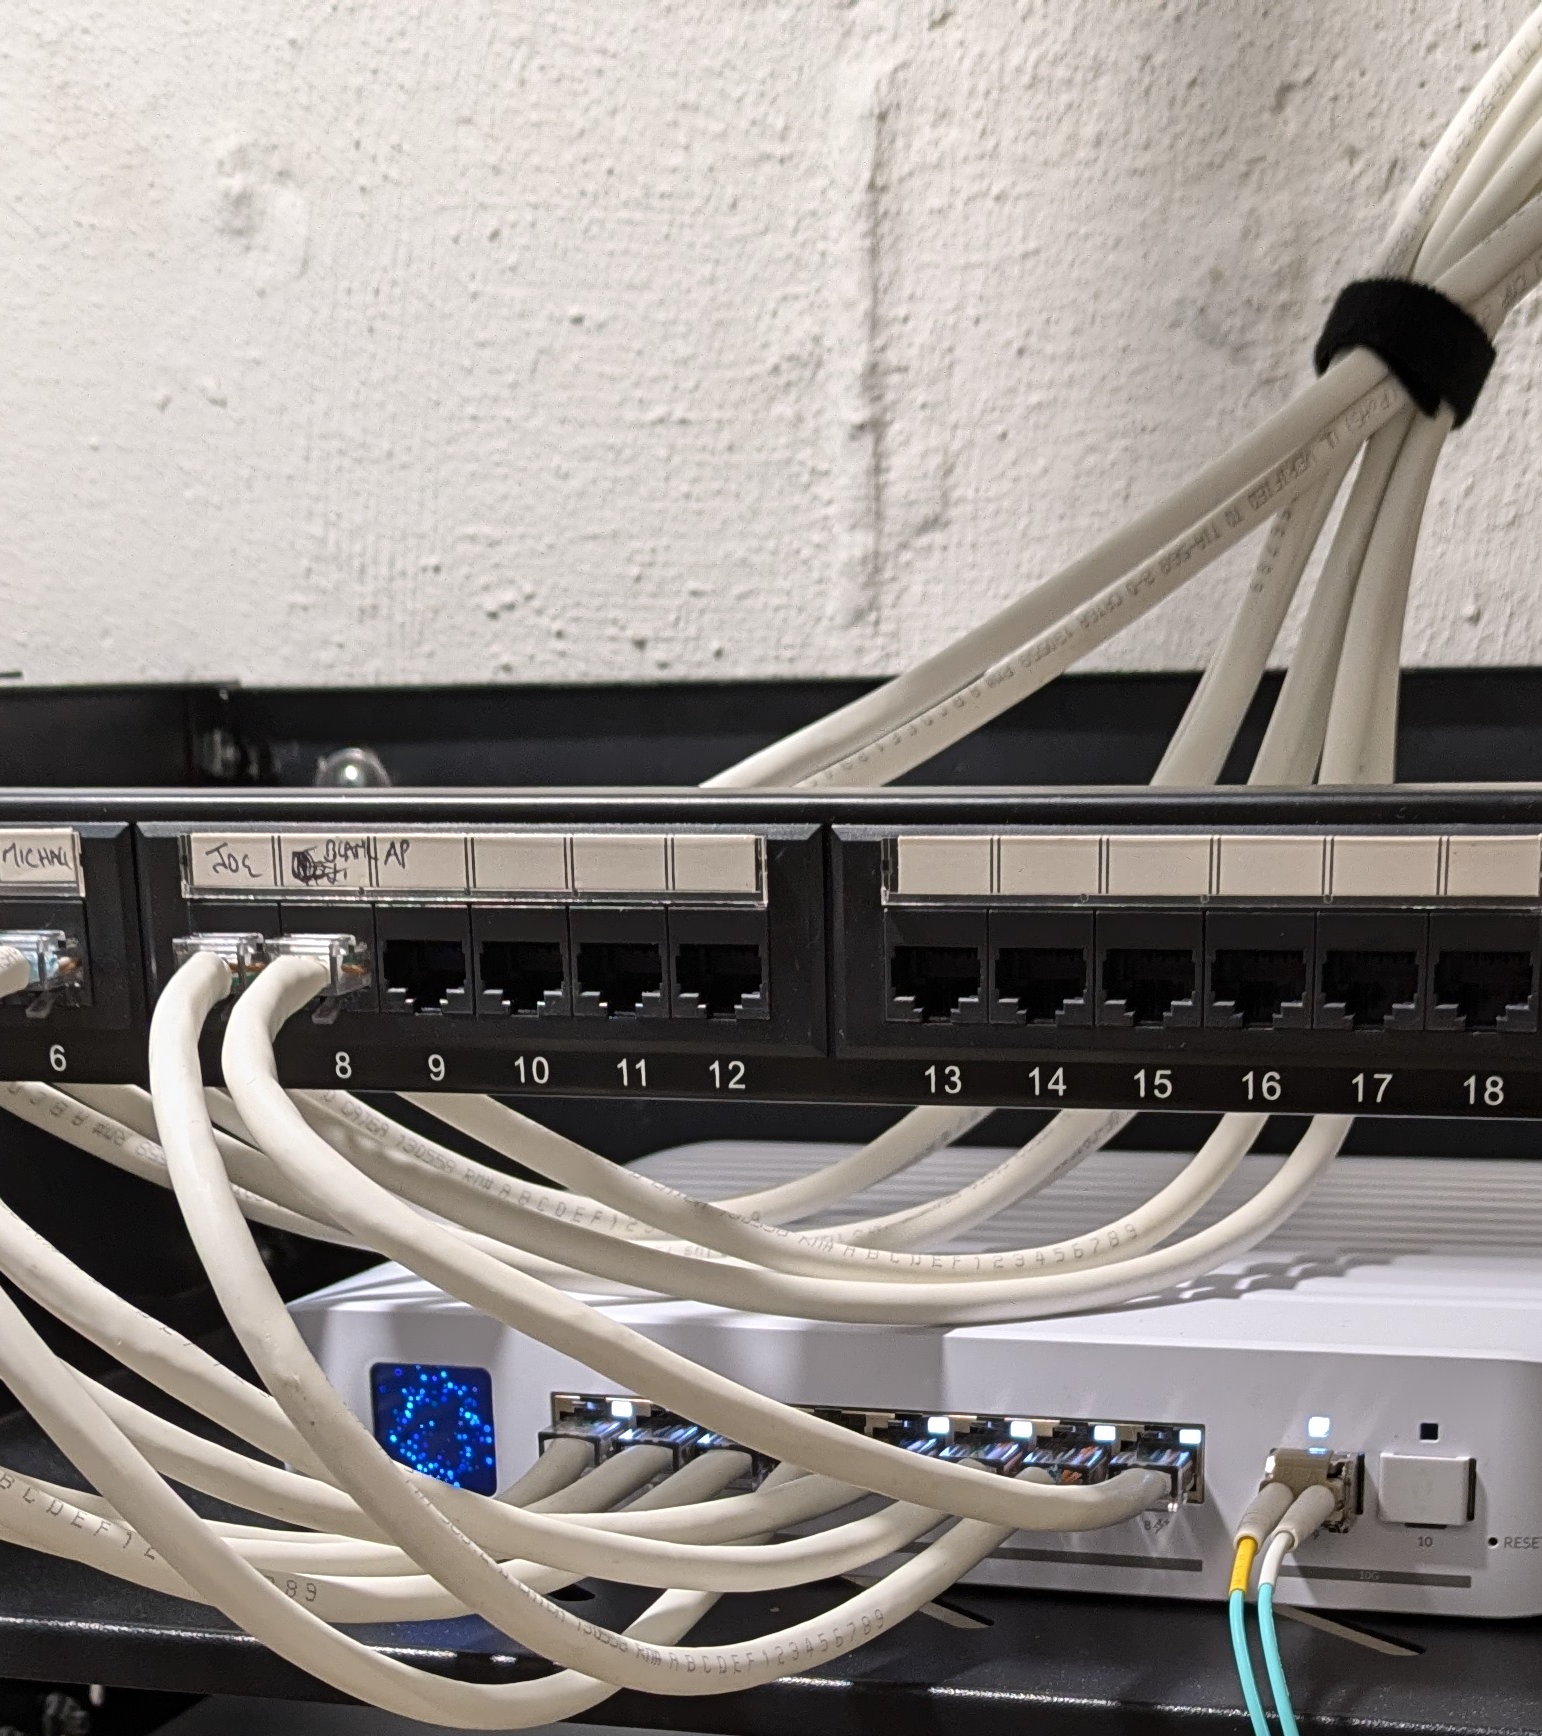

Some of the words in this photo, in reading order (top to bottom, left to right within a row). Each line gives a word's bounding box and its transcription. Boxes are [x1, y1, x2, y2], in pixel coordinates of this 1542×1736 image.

[384, 839, 410, 869] AP
[50, 1045, 66, 1071] 6
[336, 1052, 351, 1078] 8
[428, 1054, 445, 1081] 9
[515, 1056, 549, 1084] 10
[617, 1058, 646, 1086] 11
[709, 1060, 745, 1089] 12
[925, 1065, 961, 1093] 13
[1029, 1067, 1066, 1096] 14
[1134, 1069, 1172, 1098] 15
[1242, 1071, 1281, 1100] 16
[1352, 1073, 1392, 1102] 17
[1464, 1076, 1503, 1105] 18
[1418, 1536, 1434, 1548] 10
[1359, 1570, 1380, 1581] 10G
[284, 1579, 298, 1598] 8
[305, 1582, 317, 1602] 9
